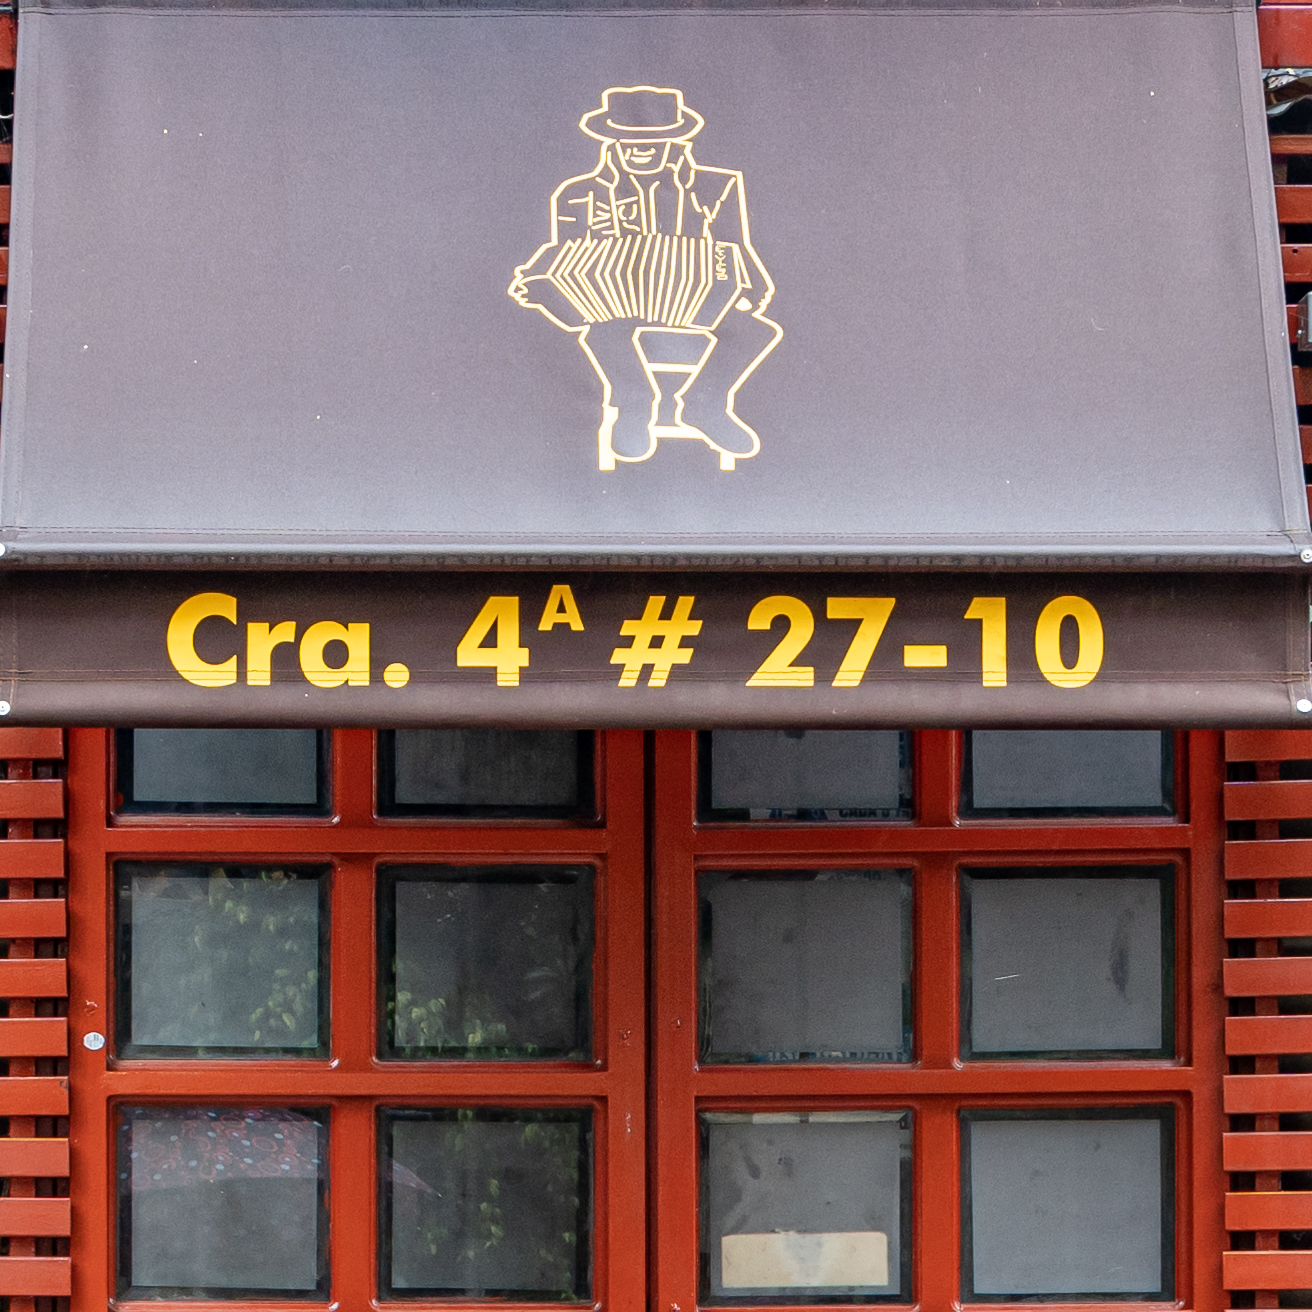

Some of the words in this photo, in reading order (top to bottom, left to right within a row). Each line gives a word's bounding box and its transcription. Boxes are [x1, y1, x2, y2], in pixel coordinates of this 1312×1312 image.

[166, 592, 411, 688] Cra.
[609, 596, 703, 687] #
[745, 595, 1105, 688] 27-10
